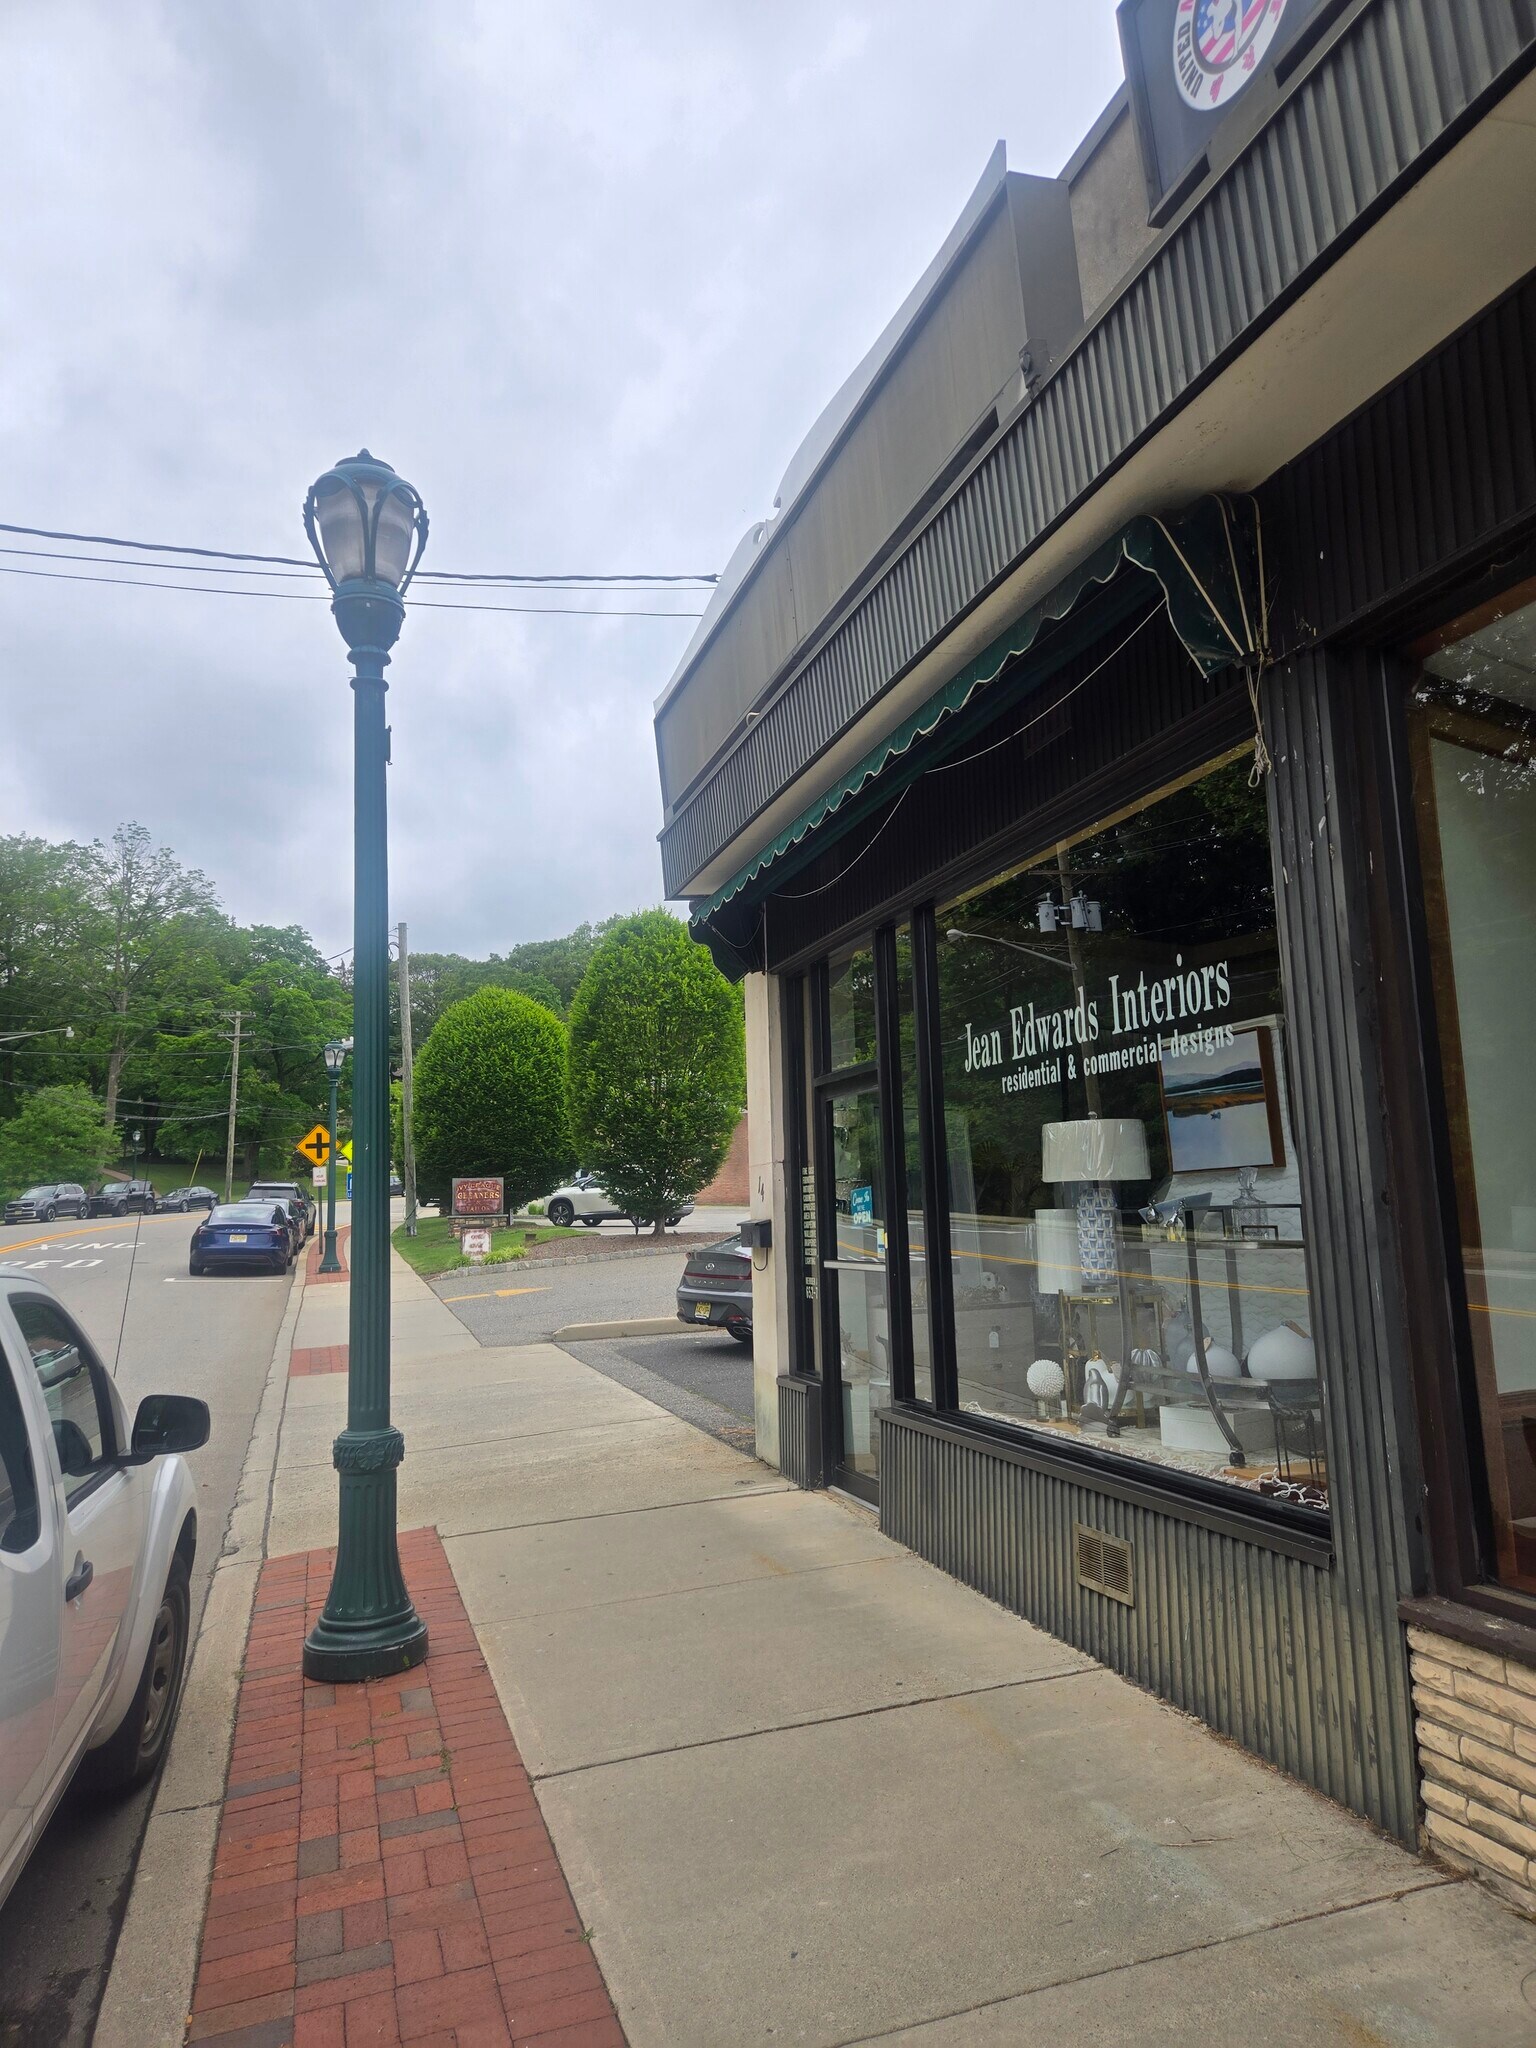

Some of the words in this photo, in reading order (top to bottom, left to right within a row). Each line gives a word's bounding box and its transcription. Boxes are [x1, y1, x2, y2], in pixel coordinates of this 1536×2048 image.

[1177, 21, 1204, 99] UNITED
[965, 1023, 1003, 1073] Jean
[1010, 986, 1099, 1060] Edwards
[1109, 953, 1231, 1035] Interiors
[1002, 1056, 1061, 1094] residential
[1067, 1053, 1077, 1079] &
[1083, 1033, 1162, 1077] commercial
[1170, 1023, 1235, 1057] designs
[457, 1191, 500, 1200] CLEANERS
[853, 1210, 871, 1225] OPEN
[27, 1242, 146, 1250] XING
